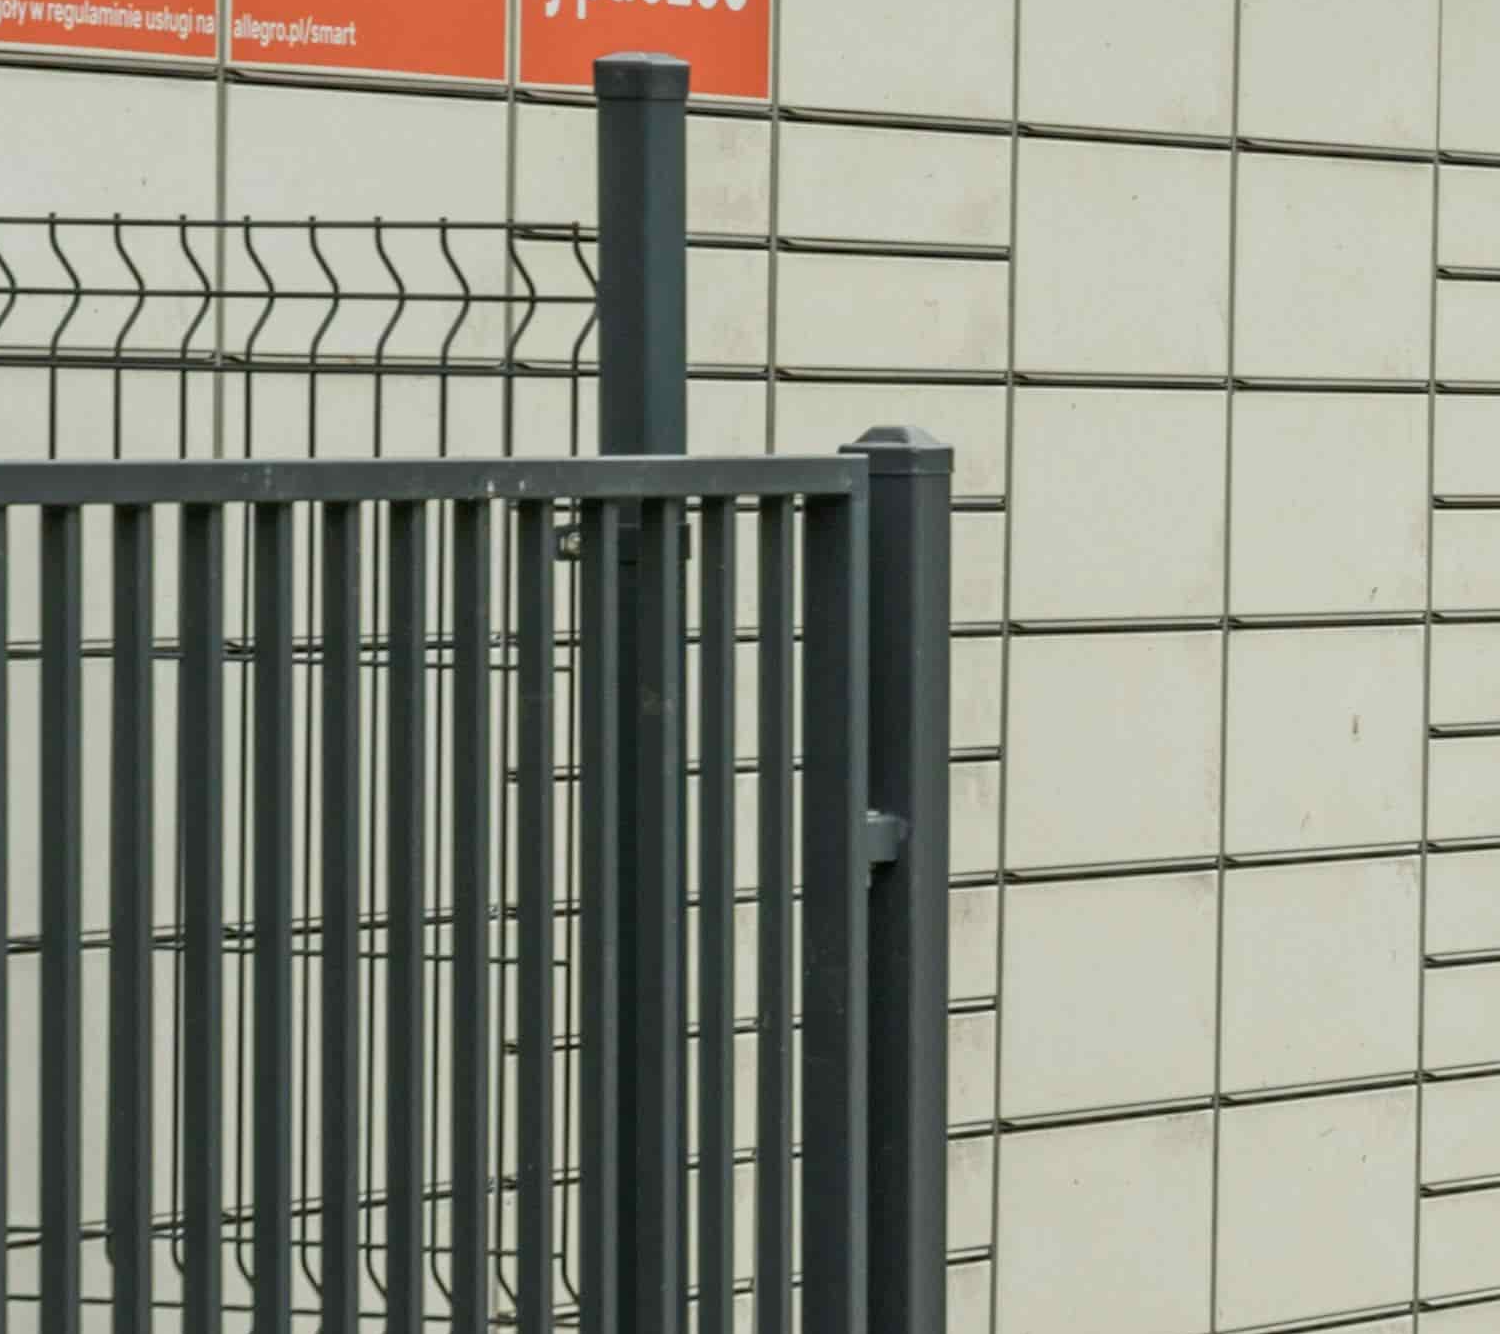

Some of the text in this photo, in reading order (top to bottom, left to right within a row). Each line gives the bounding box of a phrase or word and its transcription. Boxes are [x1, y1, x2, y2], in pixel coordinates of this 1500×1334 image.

[29, 0, 44, 20] w
[47, 0, 142, 32] regulaminie
[145, 8, 193, 40] usługi
[195, 16, 215, 36] na
[233, 13, 357, 47] allegro.pl/smart
